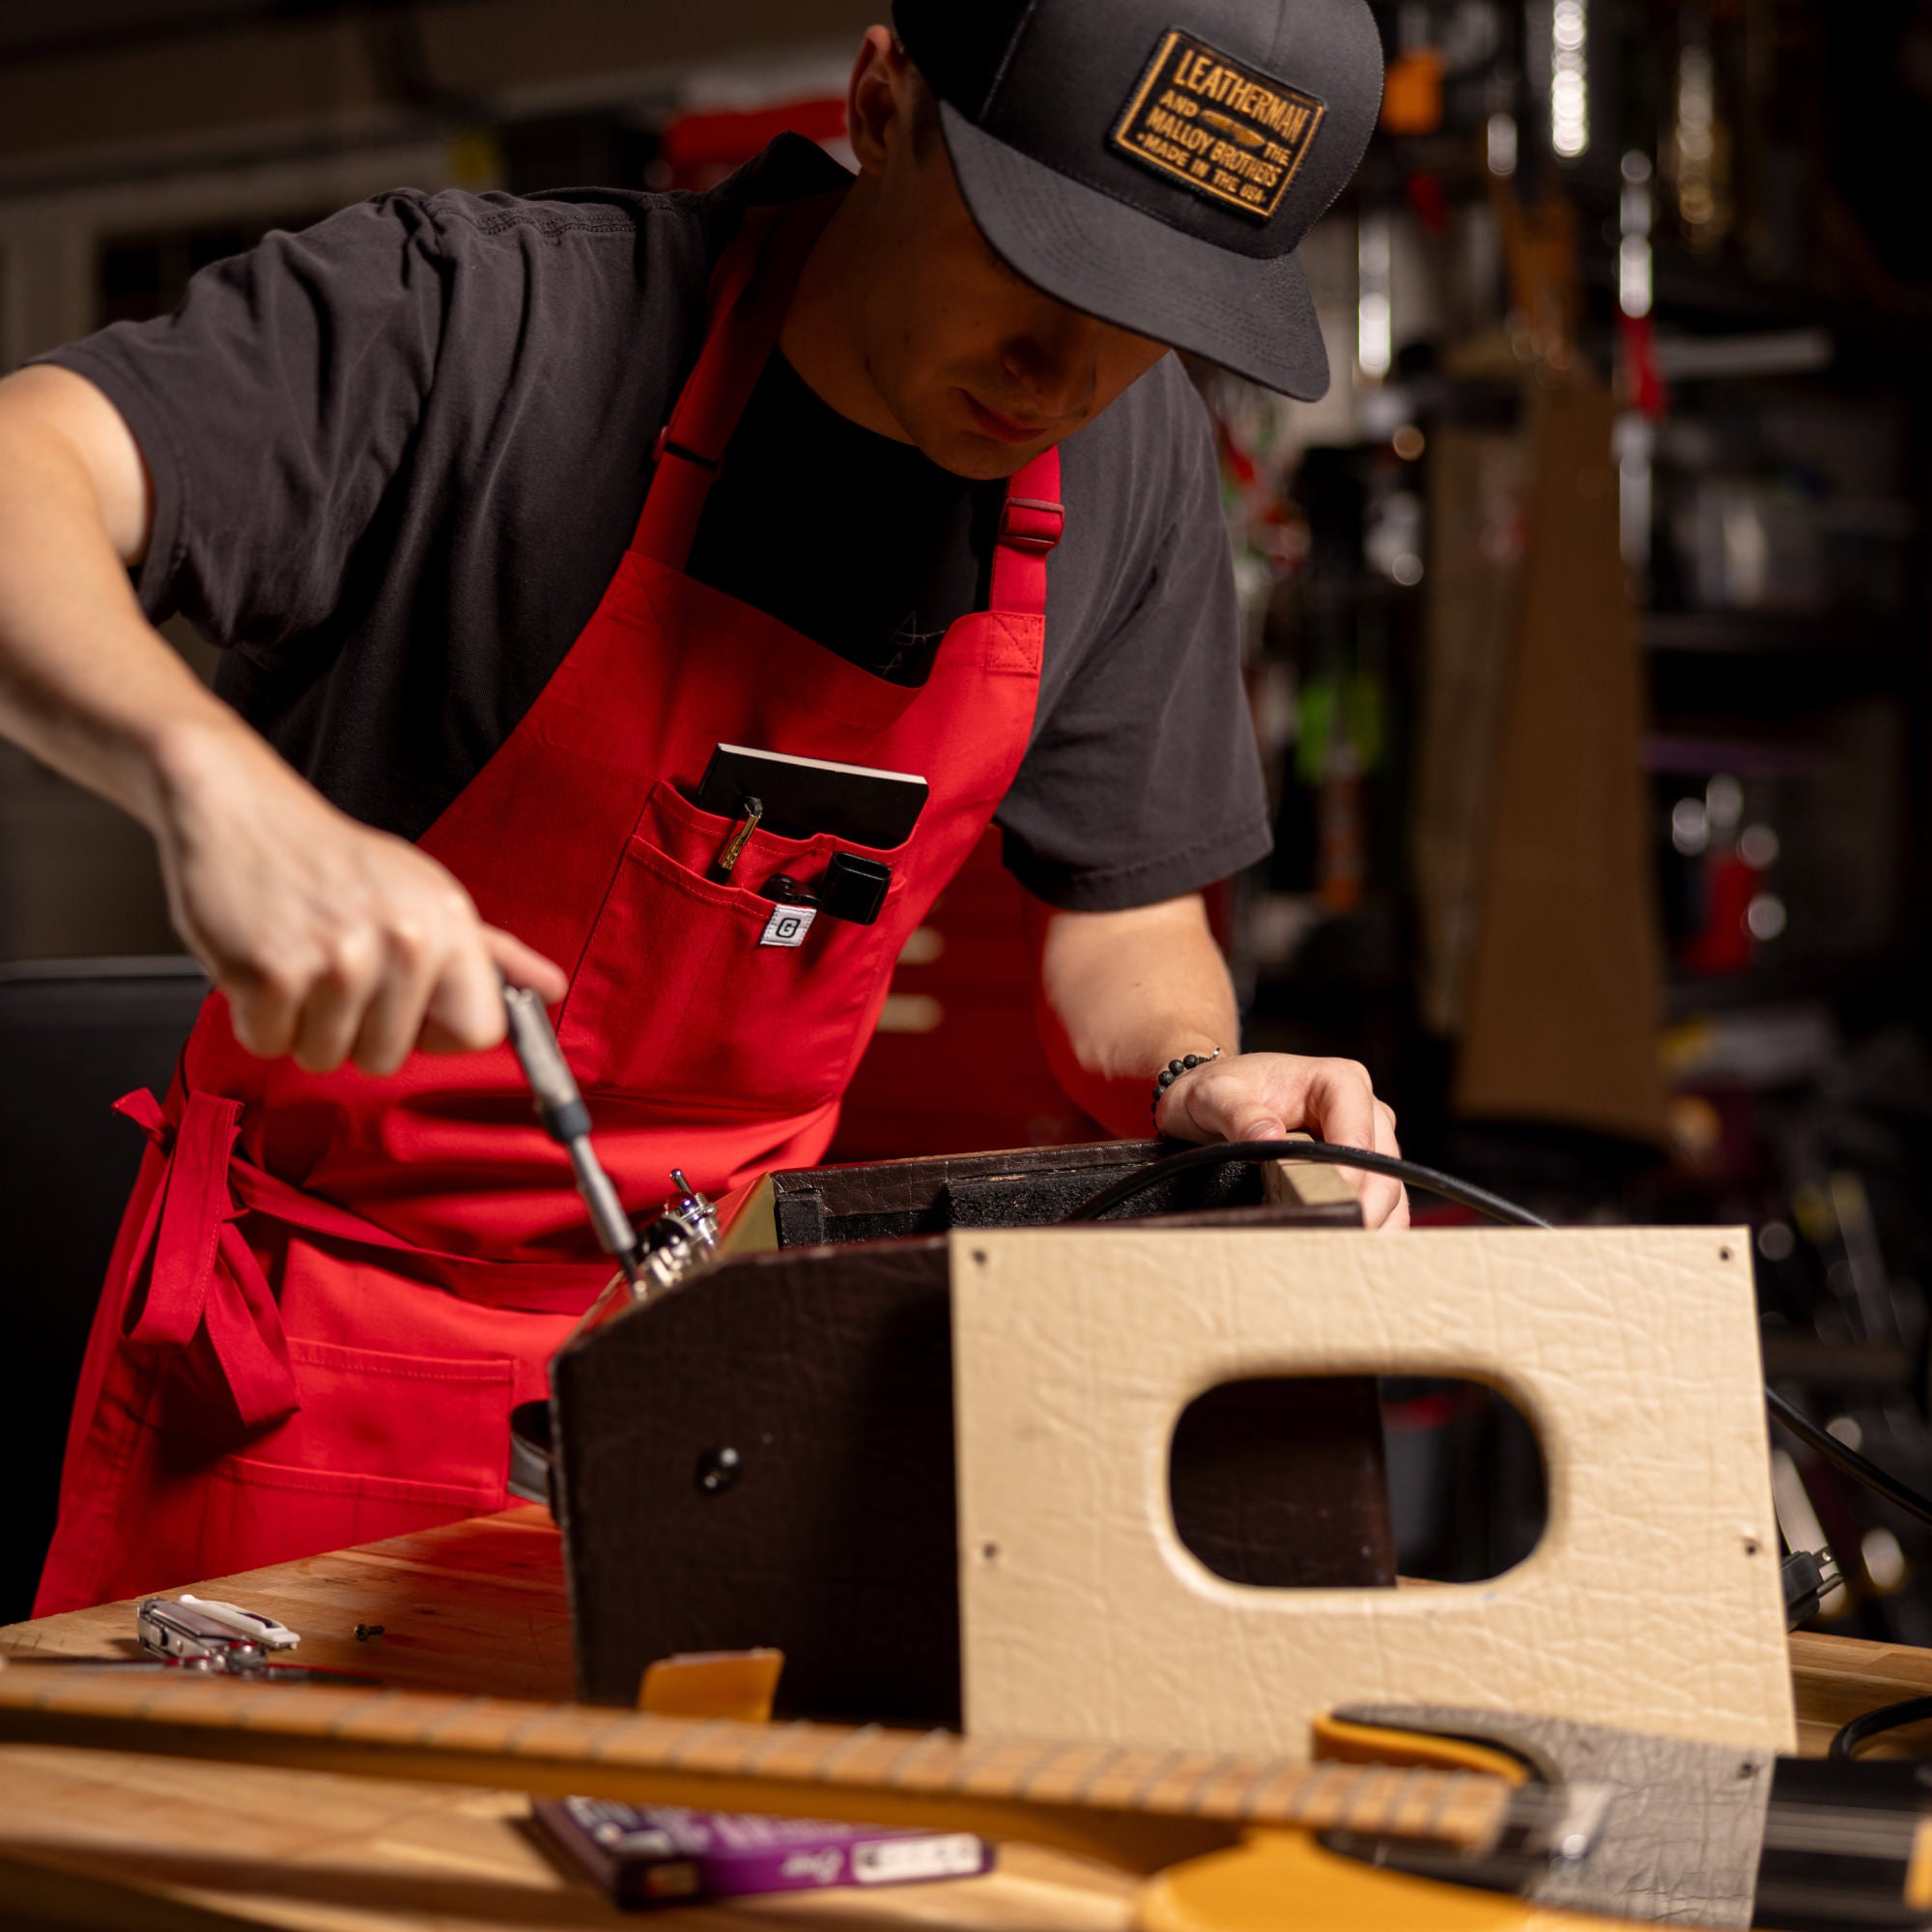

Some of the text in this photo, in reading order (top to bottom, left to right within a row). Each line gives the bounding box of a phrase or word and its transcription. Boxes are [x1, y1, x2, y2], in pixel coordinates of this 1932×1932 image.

[1159, 89, 1292, 166] AND THE
[1172, 49, 1311, 144] LEATHERMAN
[1145, 105, 1283, 187] MALLOY BROTHERS
[1189, 157, 1210, 178] IN
[1212, 168, 1240, 193] THE
